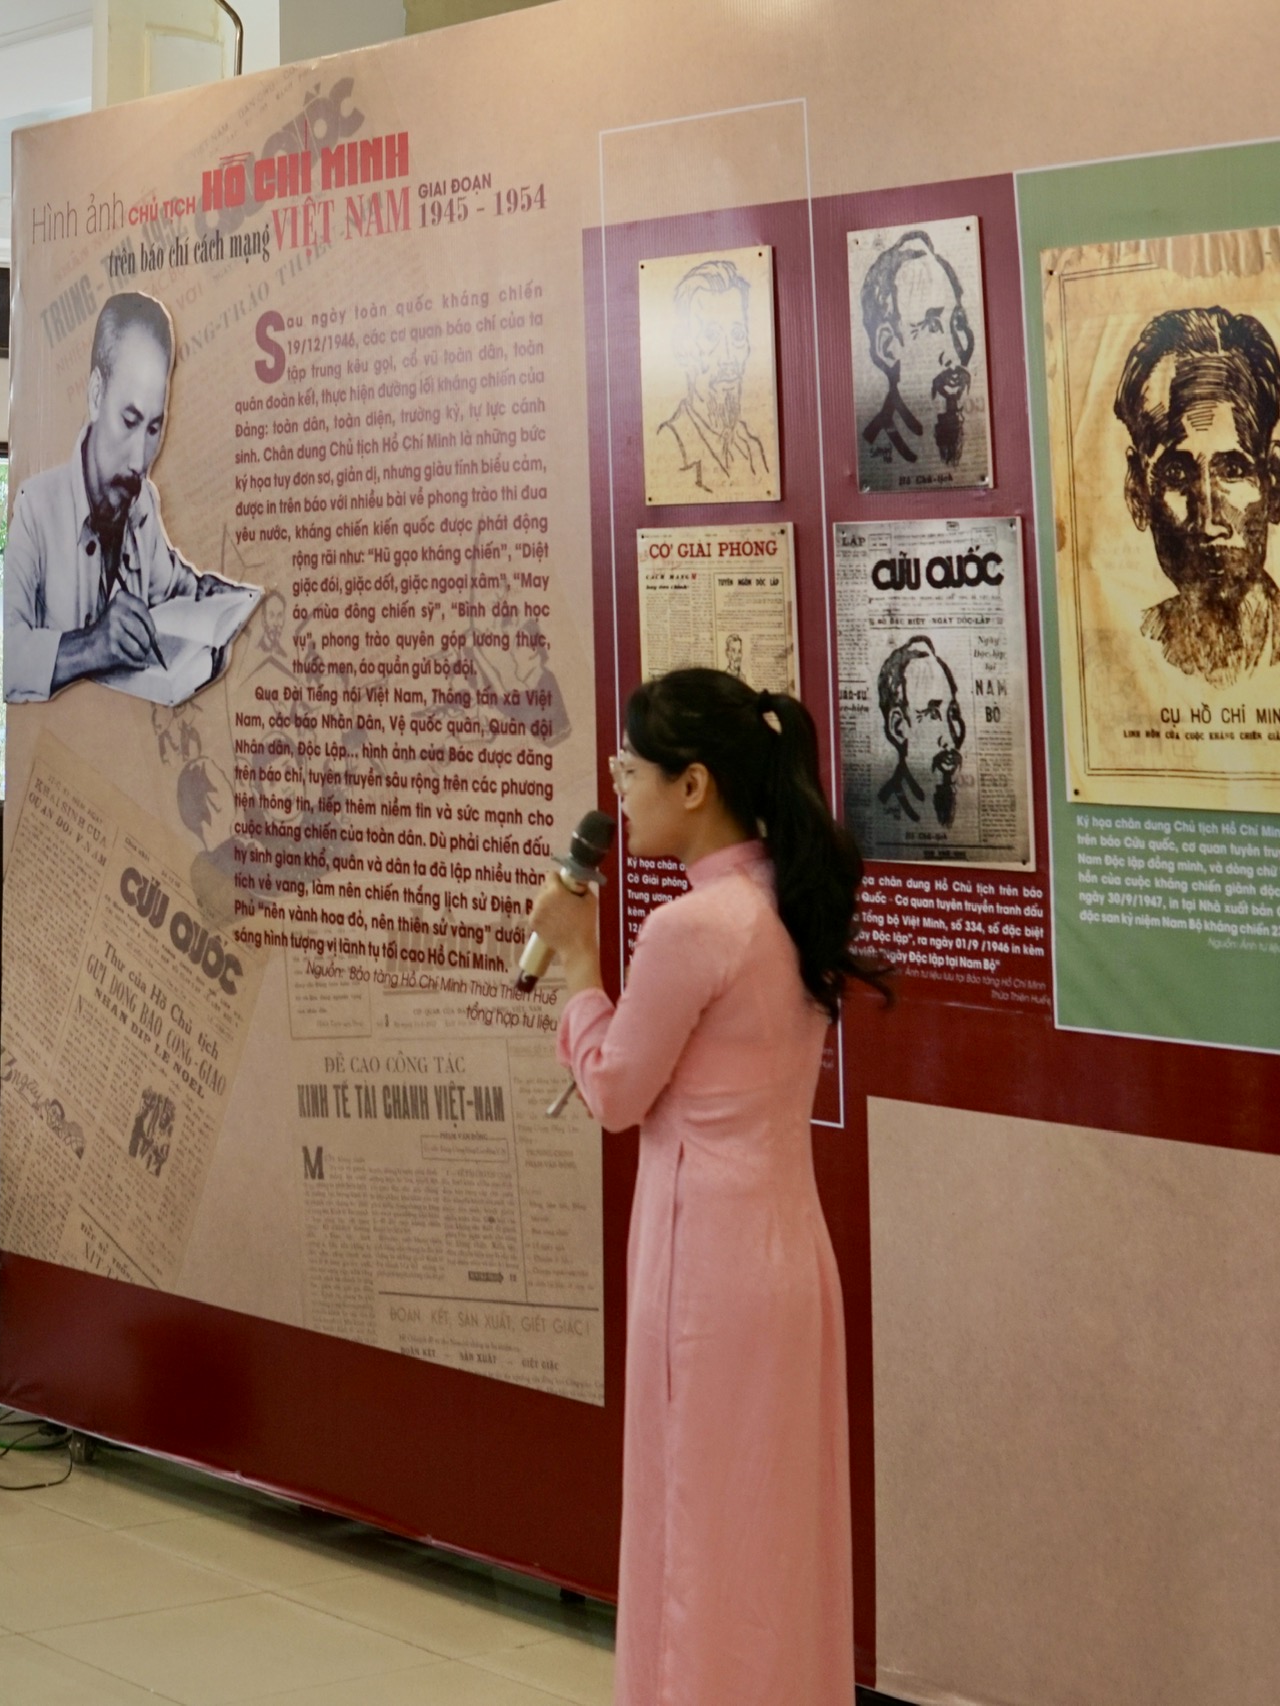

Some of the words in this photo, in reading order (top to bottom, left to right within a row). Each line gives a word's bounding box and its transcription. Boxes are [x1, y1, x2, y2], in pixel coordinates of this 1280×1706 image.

[32, 202, 77, 245] Hình
[86, 192, 124, 234] ảnh
[128, 196, 158, 226] CHỦ
[163, 196, 195, 225] TỊCH
[202, 152, 251, 212] HỒ
[254, 119, 311, 201] CHÍ
[321, 132, 409, 190] MINH
[418, 180, 446, 198] GIAI
[451, 173, 491, 195] ĐOẠN
[419, 197, 468, 228] 1945
[494, 184, 546, 216] 1954
[109, 253, 135, 277] trên
[141, 243, 163, 272] báo
[170, 237, 189, 267] chí
[194, 230, 223, 264] cách
[230, 224, 270, 264] mạng
[272, 196, 334, 257] VIỆT
[344, 186, 411, 240] NAM
[235, 451, 260, 464] sinh.
[263, 446, 293, 461] Chân
[296, 442, 326, 461] dung
[330, 439, 353, 456] Chủ
[357, 438, 379, 457] tịch
[382, 432, 398, 452] Hồ
[402, 435, 423, 450] Chí
[427, 433, 456, 447] Minh
[460, 431, 472, 445] là
[476, 428, 517, 446] những
[520, 425, 545, 442] bức
[926, 545, 1004, 589] QUỐC
[255, 687, 278, 701] Qua
[283, 687, 302, 701] Đài
[308, 684, 337, 705] Tiếng
[343, 687, 361, 701] nói
[366, 687, 389, 708] Việt
[394, 688, 426, 705] Nam,
[432, 688, 470, 708] Thông
[476, 686, 498, 705] tấn
[503, 690, 521, 705] xã
[525, 690, 552, 710] Việt
[1161, 708, 1180, 727] CỤ
[1191, 703, 1212, 723] HỒ
[1222, 704, 1245, 723] CHÍ
[1256, 708, 1280, 723] MIN
[1077, 815, 1089, 828] Ký
[1092, 816, 1111, 830] họa
[1115, 817, 1141, 829] chân
[1144, 820, 1170, 834] dung
[1174, 820, 1195, 832] Chủ
[1199, 821, 1218, 836] tịch
[1221, 821, 1236, 835] Hồ
[1240, 824, 1258, 836] Chí
[1262, 825, 1280, 837] Min
[862, 877, 874, 886] ọa
[879, 876, 902, 887] chân
[907, 879, 930, 892] dung
[935, 878, 948, 891] Hồ
[953, 881, 972, 892] Chủ
[977, 884, 994, 896] tịch
[999, 885, 1018, 896] trên
[1023, 887, 1042, 898] báo
[170, 911, 243, 995] QUỐC
